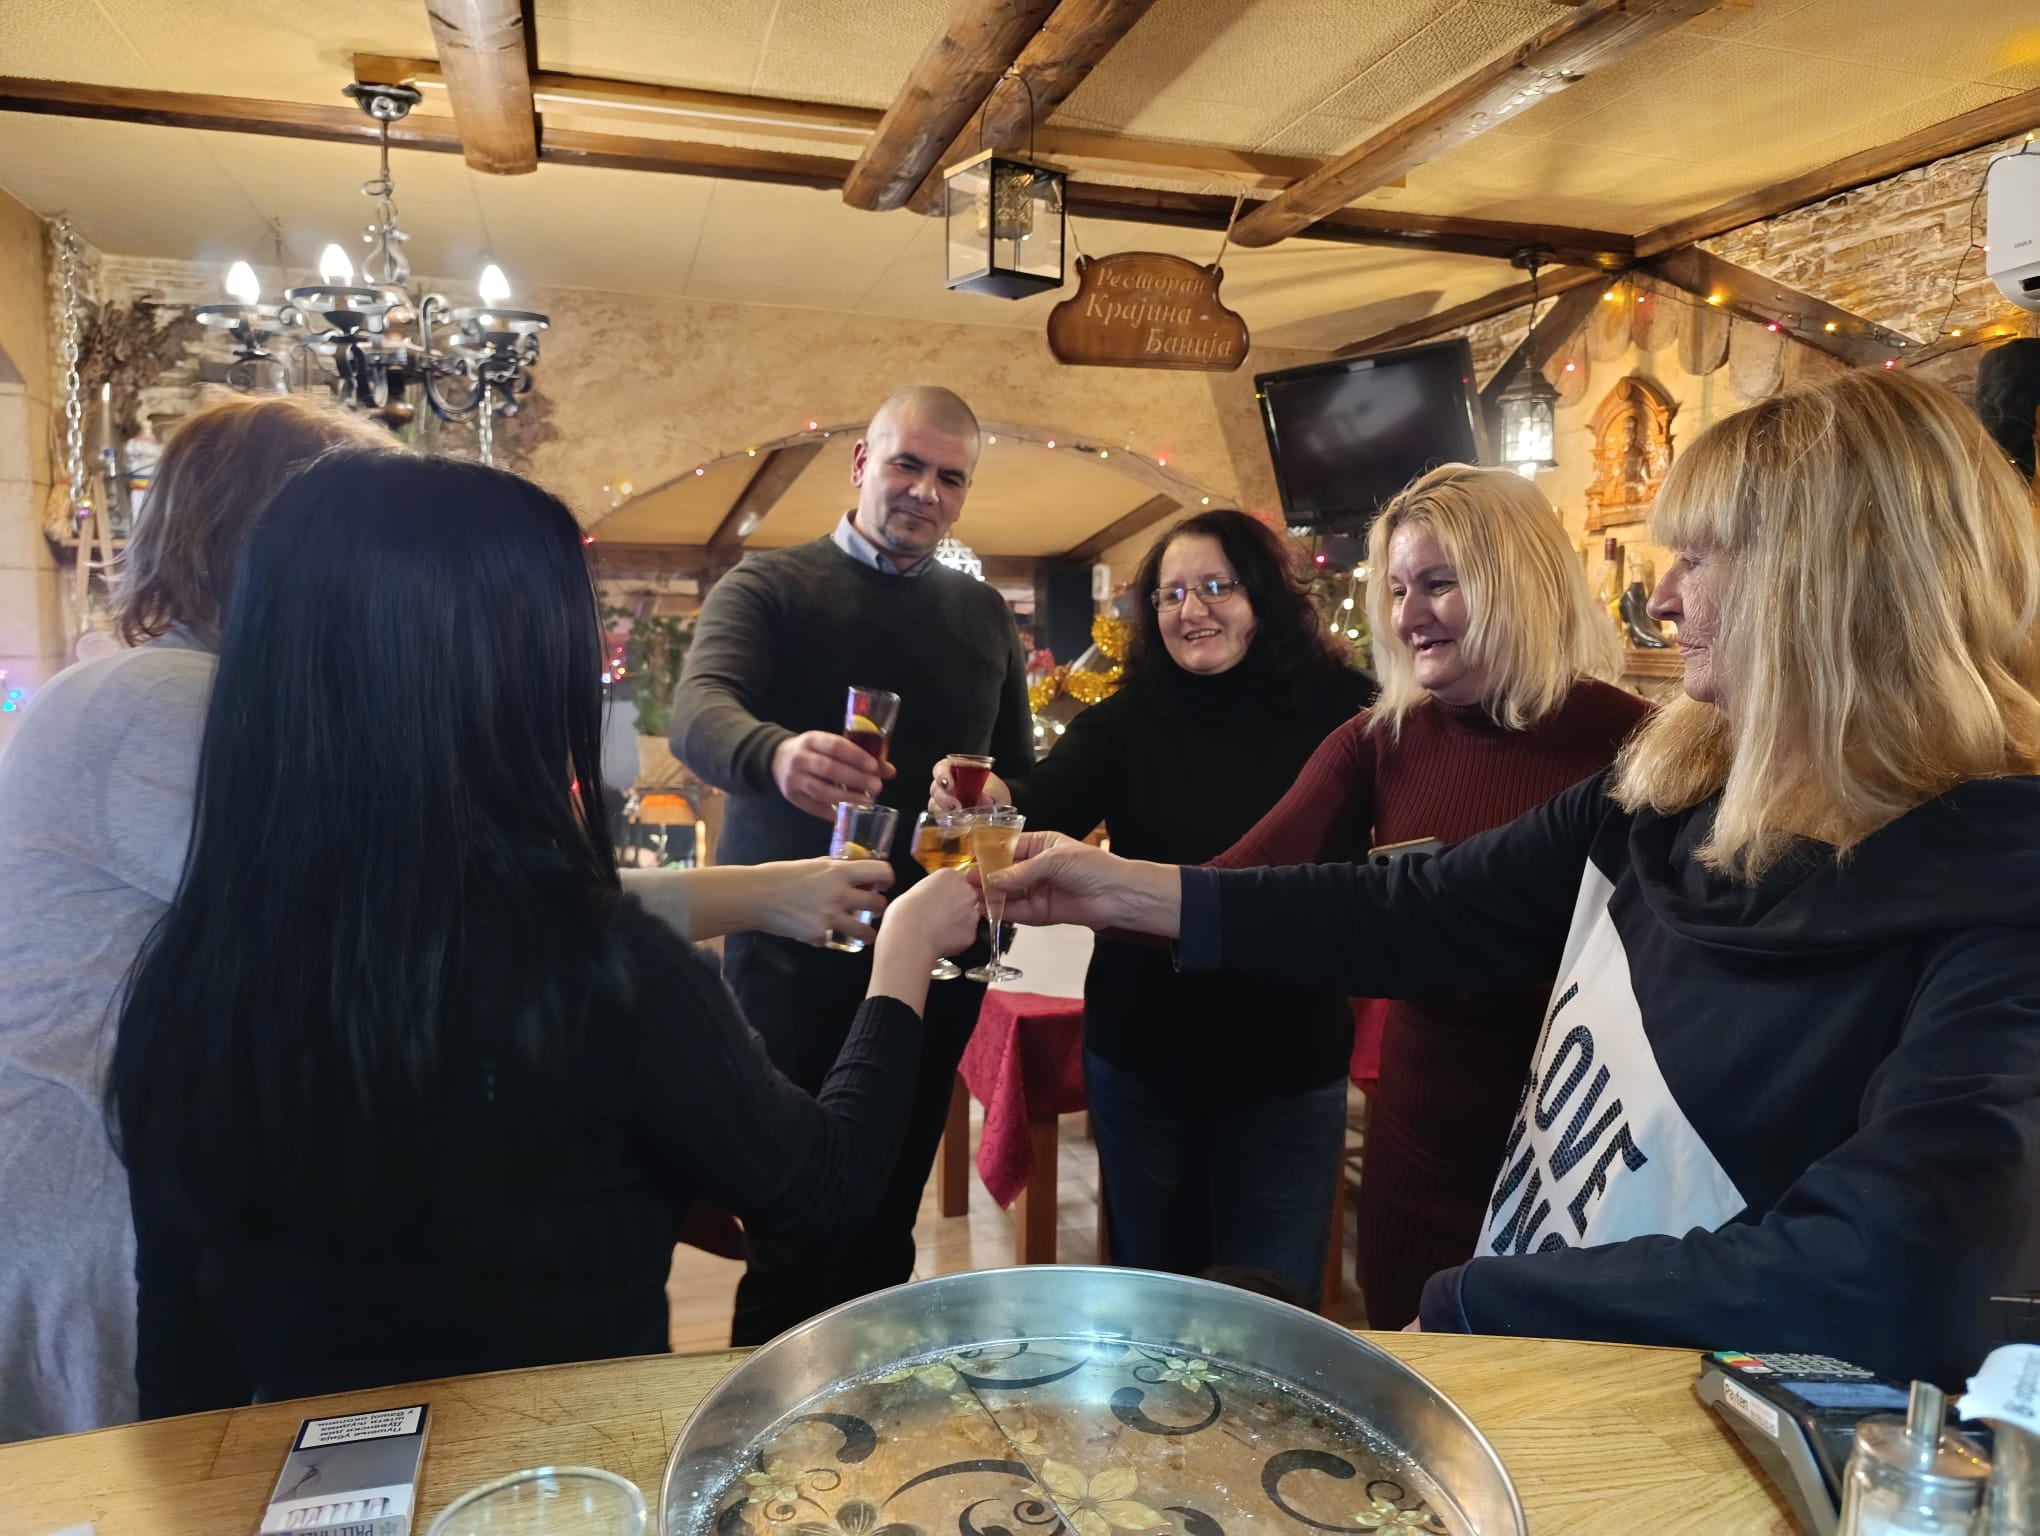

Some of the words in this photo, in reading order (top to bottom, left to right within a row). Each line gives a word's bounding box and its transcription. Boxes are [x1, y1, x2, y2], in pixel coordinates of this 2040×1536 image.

[1096, 268, 1207, 296] Ресторан
[1085, 292, 1193, 329] Крајина
[1145, 328, 1232, 360] Банија
